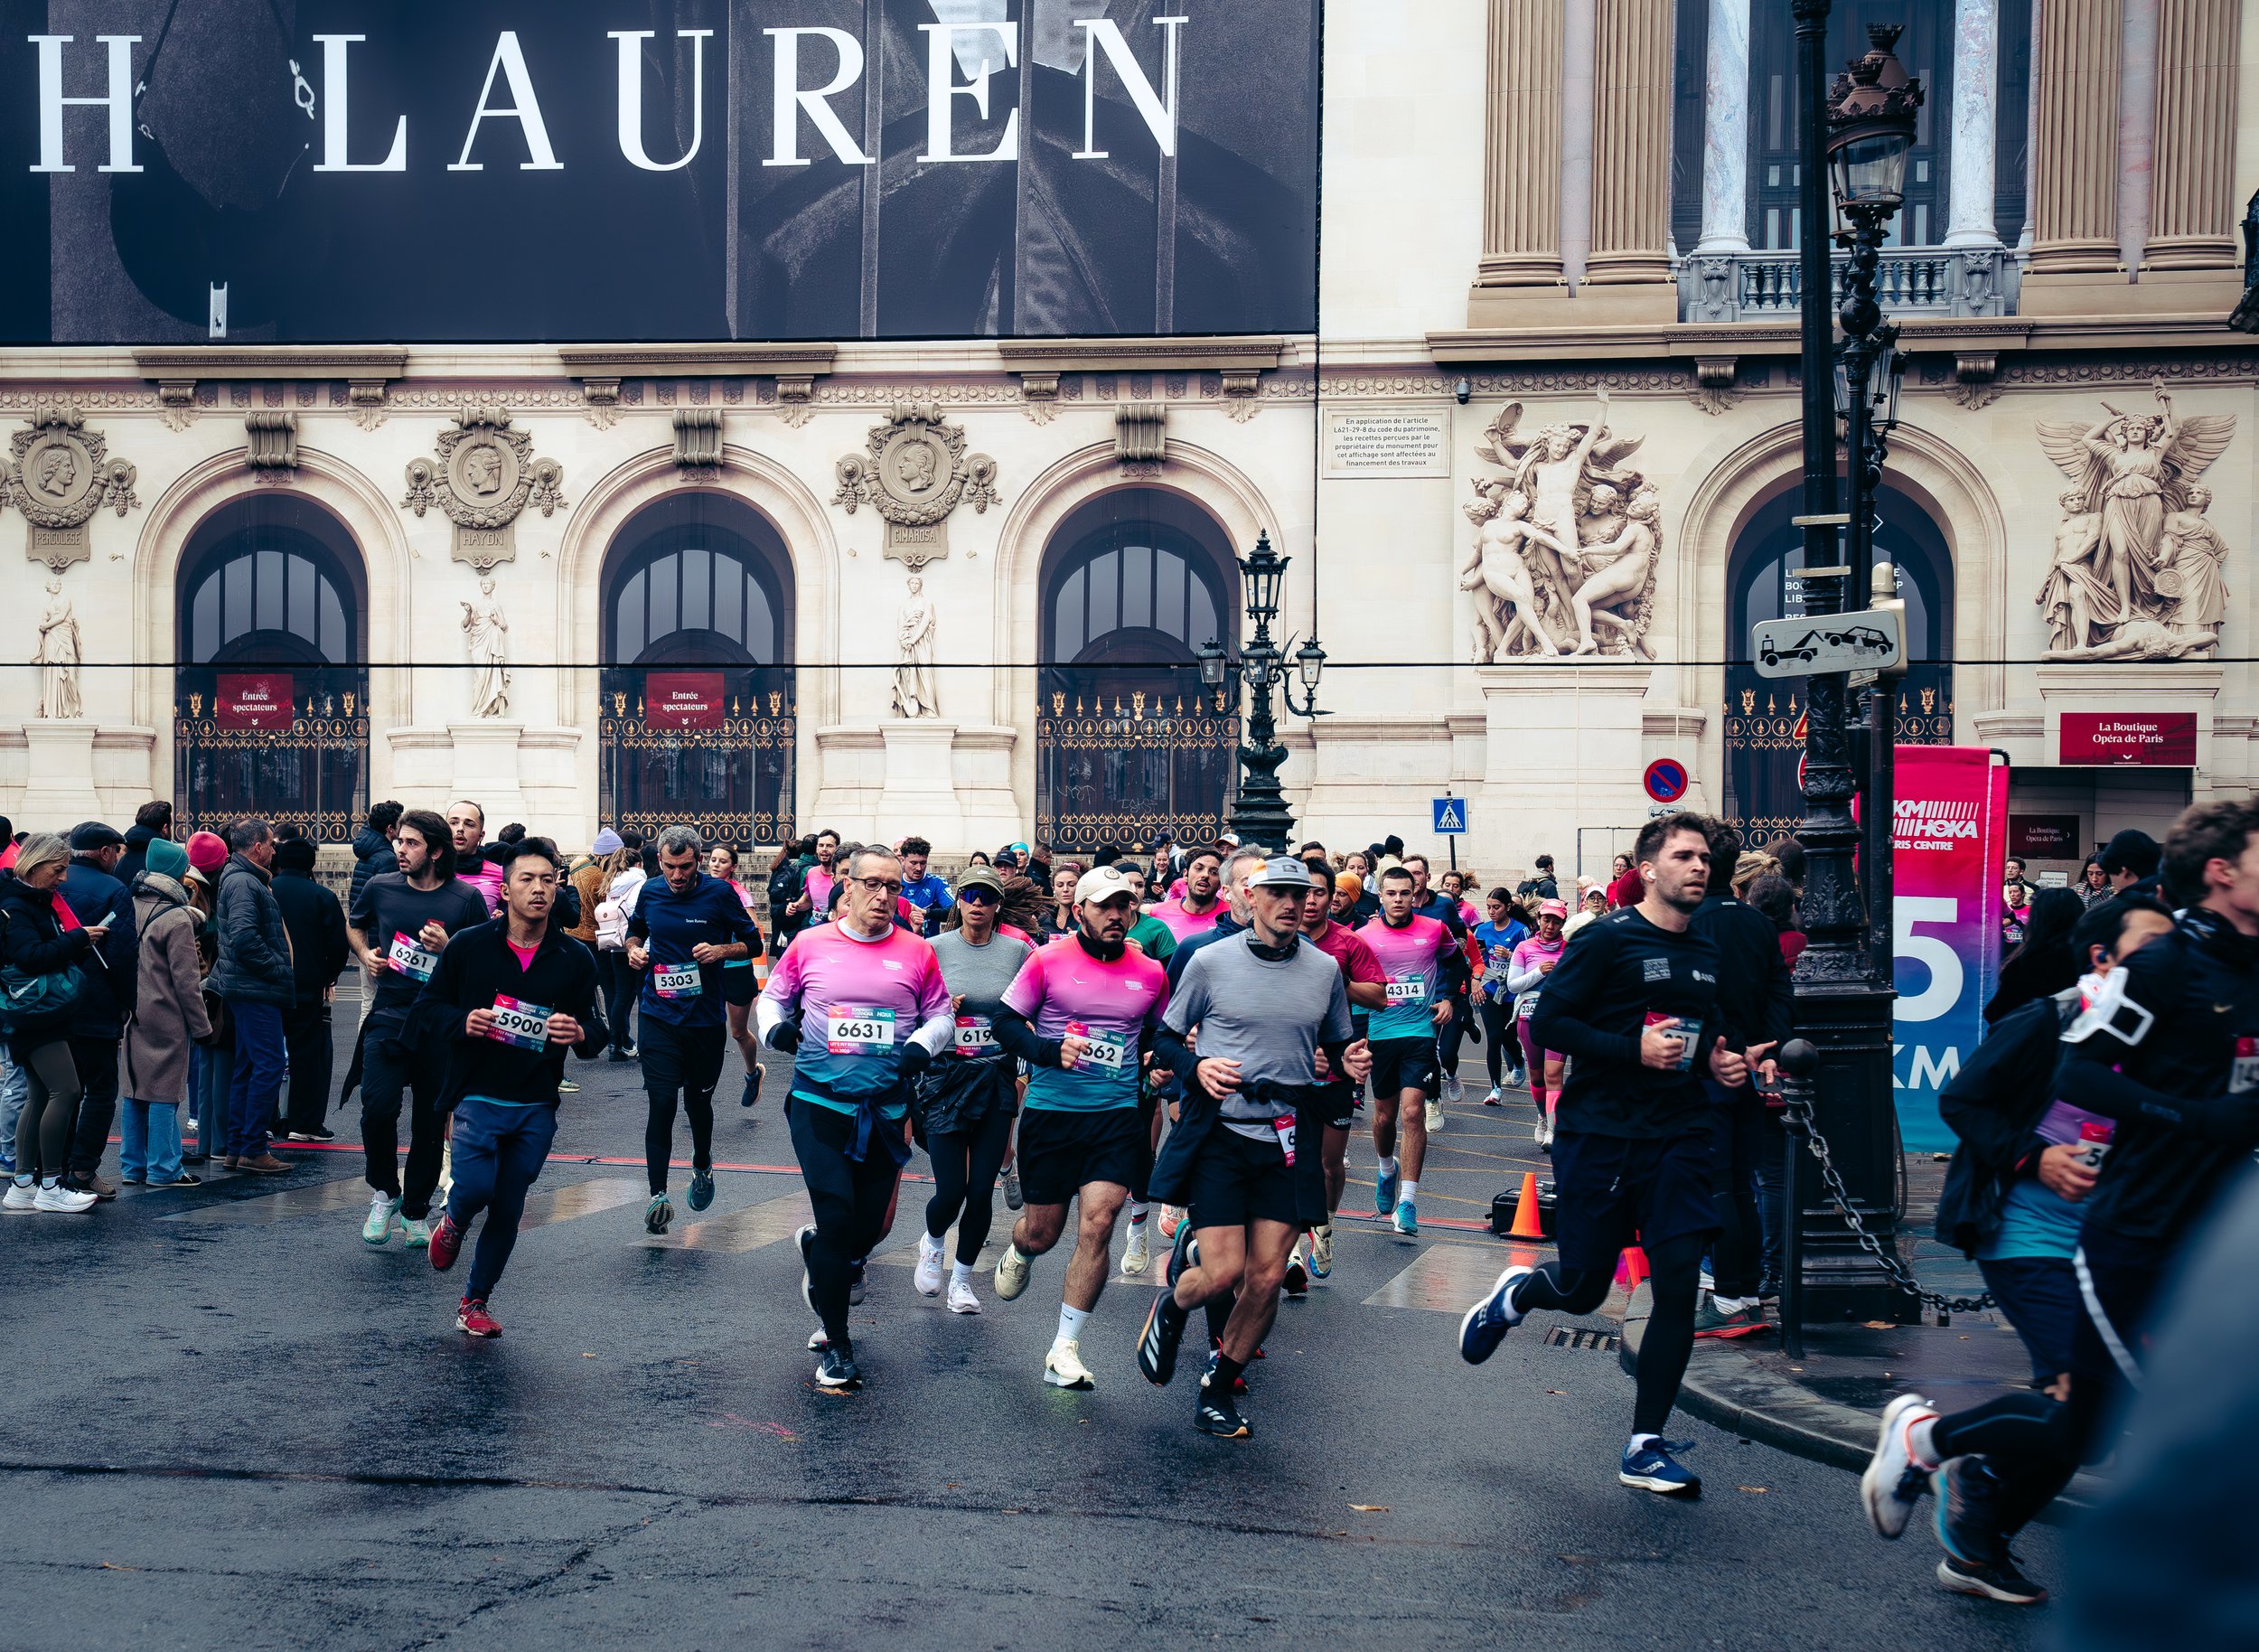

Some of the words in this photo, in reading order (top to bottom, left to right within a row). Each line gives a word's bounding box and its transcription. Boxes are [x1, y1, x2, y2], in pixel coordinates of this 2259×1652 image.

[314, 16, 1189, 173] LAUREN
[1355, 418, 1392, 426] application
[1403, 426, 1440, 434] patrimoine,
[463, 533, 504, 546] HAYDN
[895, 529, 936, 543] CIMAROSA
[242, 692, 268, 700] Entrée
[672, 691, 698, 699] Entrée
[232, 704, 277, 713] spectateurs
[662, 704, 708, 712] spectateurs
[2099, 722, 2111, 731] La
[2114, 722, 2158, 733] Boutique
[2092, 734, 2123, 745] Opéra
[2124, 734, 2137, 743] de
[2139, 734, 2164, 743] Paris
[1914, 819, 1979, 839] HOKA
[2037, 827, 2060, 835] Boutique
[1913, 840, 1954, 850] CENTRE
[396, 947, 428, 968] 6261
[1893, 896, 1964, 1021] 5
[661, 974, 694, 987] 5303
[1388, 985, 1419, 996] 4314
[498, 1011, 544, 1036] 5900
[837, 1022, 883, 1039] 6631
[1288, 1131, 1296, 1146] 6
[2086, 1147, 2103, 1167] 5
